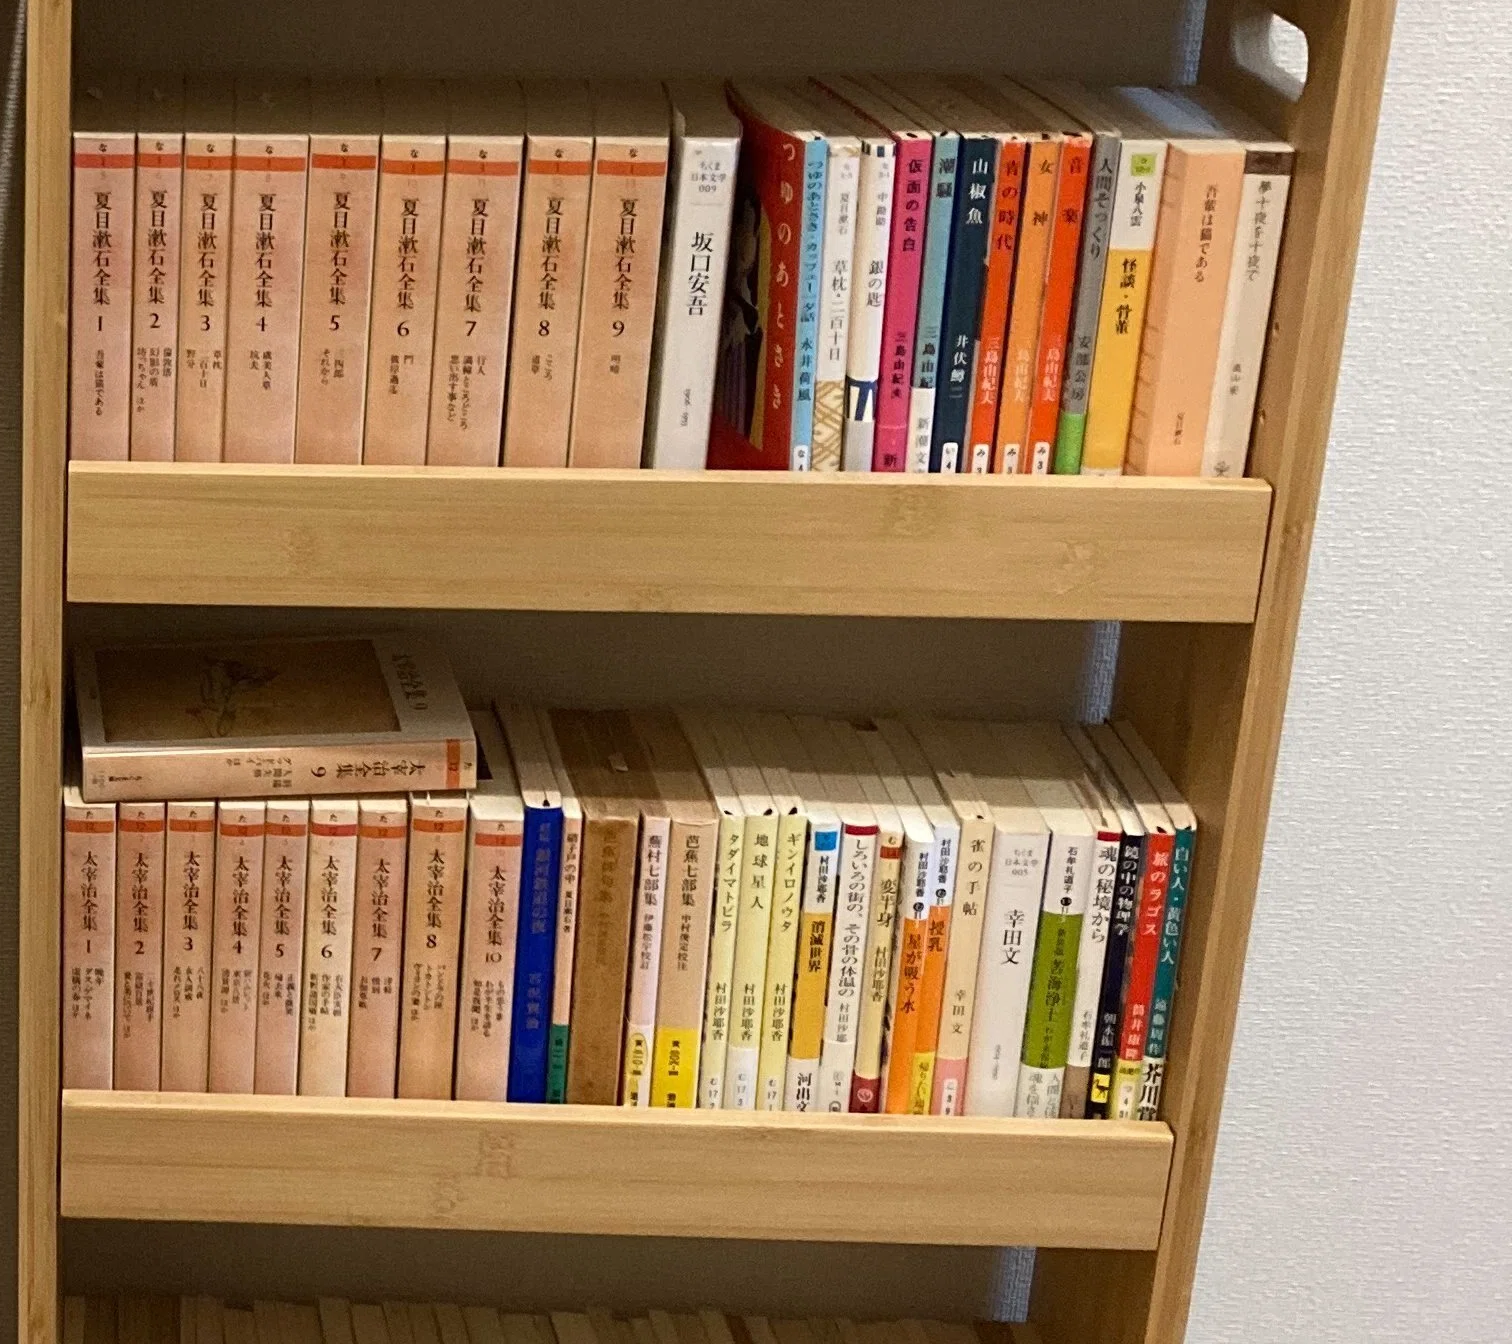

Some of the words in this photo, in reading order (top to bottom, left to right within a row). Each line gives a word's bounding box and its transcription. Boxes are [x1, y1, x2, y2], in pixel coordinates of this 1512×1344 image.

[899, 158, 924, 253] 仮面の告白
[965, 157, 990, 226] 山椒魚
[995, 158, 1020, 252] 青の時代
[1031, 158, 1056, 227] 女神
[1060, 158, 1084, 226] 音楽
[1089, 157, 1114, 260] 人間そっくり
[92, 190, 112, 307] 夏目漱石全集
[146, 189, 168, 306] 夏目漱石全集
[196, 191, 218, 309] 夏目漱石全集
[254, 191, 277, 309] 夏目漱石全集
[329, 190, 352, 307] 夏目漱石全集
[396, 196, 420, 312] 夏目漱石全集
[464, 197, 491, 314] 夏目漱石全集
[536, 195, 565, 311] 夏目漱石全集
[611, 197, 639, 312] 夏目漱石全集
[1193, 183, 1222, 285] 吾輩は猫である
[686, 231, 715, 316] 坂口安吾
[826, 259, 850, 362] 草枕・二百十日
[96, 314, 104, 333] 1
[148, 312, 162, 330] 2
[199, 314, 212, 332] 3
[255, 314, 269, 333] 4
[328, 314, 341, 332] 5
[395, 319, 411, 337] 6
[464, 319, 478, 338] 7
[537, 319, 551, 337] 8
[611, 319, 625, 338] 9
[310, 766, 326, 778] 9
[336, 758, 426, 779] 太宰治全集
[79, 850, 99, 934] 太宰治全集
[129, 851, 149, 934] 太宰治全集
[181, 849, 200, 932] 太宰治全集
[230, 854, 249, 938] 太宰治全集
[271, 854, 292, 936] 太宰治全集
[319, 854, 340, 937] 太宰治全集
[369, 857, 390, 940] 太宰治全集
[425, 848, 445, 930] 太宰治全集
[486, 864, 507, 947] 太宰治全集
[719, 832, 740, 934] タダイマトビラ
[748, 833, 770, 910] 地球星人
[778, 832, 802, 932] ギンイロノウタ
[874, 878, 897, 929] 変半身
[960, 839, 986, 918] 雀の手帖
[1089, 845, 1116, 944] 魂の秘境から
[1113, 844, 1140, 937] 鏡の中の物理学
[1137, 851, 1168, 937] 旅のラゴス
[1157, 846, 1189, 967] 白い人・黄色い人
[83, 938, 92, 955] 1
[133, 939, 145, 955] 2
[181, 936, 193, 952] 3
[229, 939, 243, 955] 4
[273, 942, 285, 959] 5
[319, 943, 334, 960] 6
[369, 947, 382, 962] 7
[425, 932, 437, 949] 8
[806, 920, 826, 973] 消滅世界
[836, 837, 870, 997] しろいろの街の、その骨の体温の
[926, 919, 945, 953] 授乳
[997, 909, 1025, 967] 幸田文
[483, 951, 502, 965] 10
[711, 982, 727, 1042] 村田沙耶香
[739, 982, 756, 1042] 村田沙耶香
[770, 982, 787, 1042] 村田沙耶香
[948, 988, 966, 1035] 幸田文
